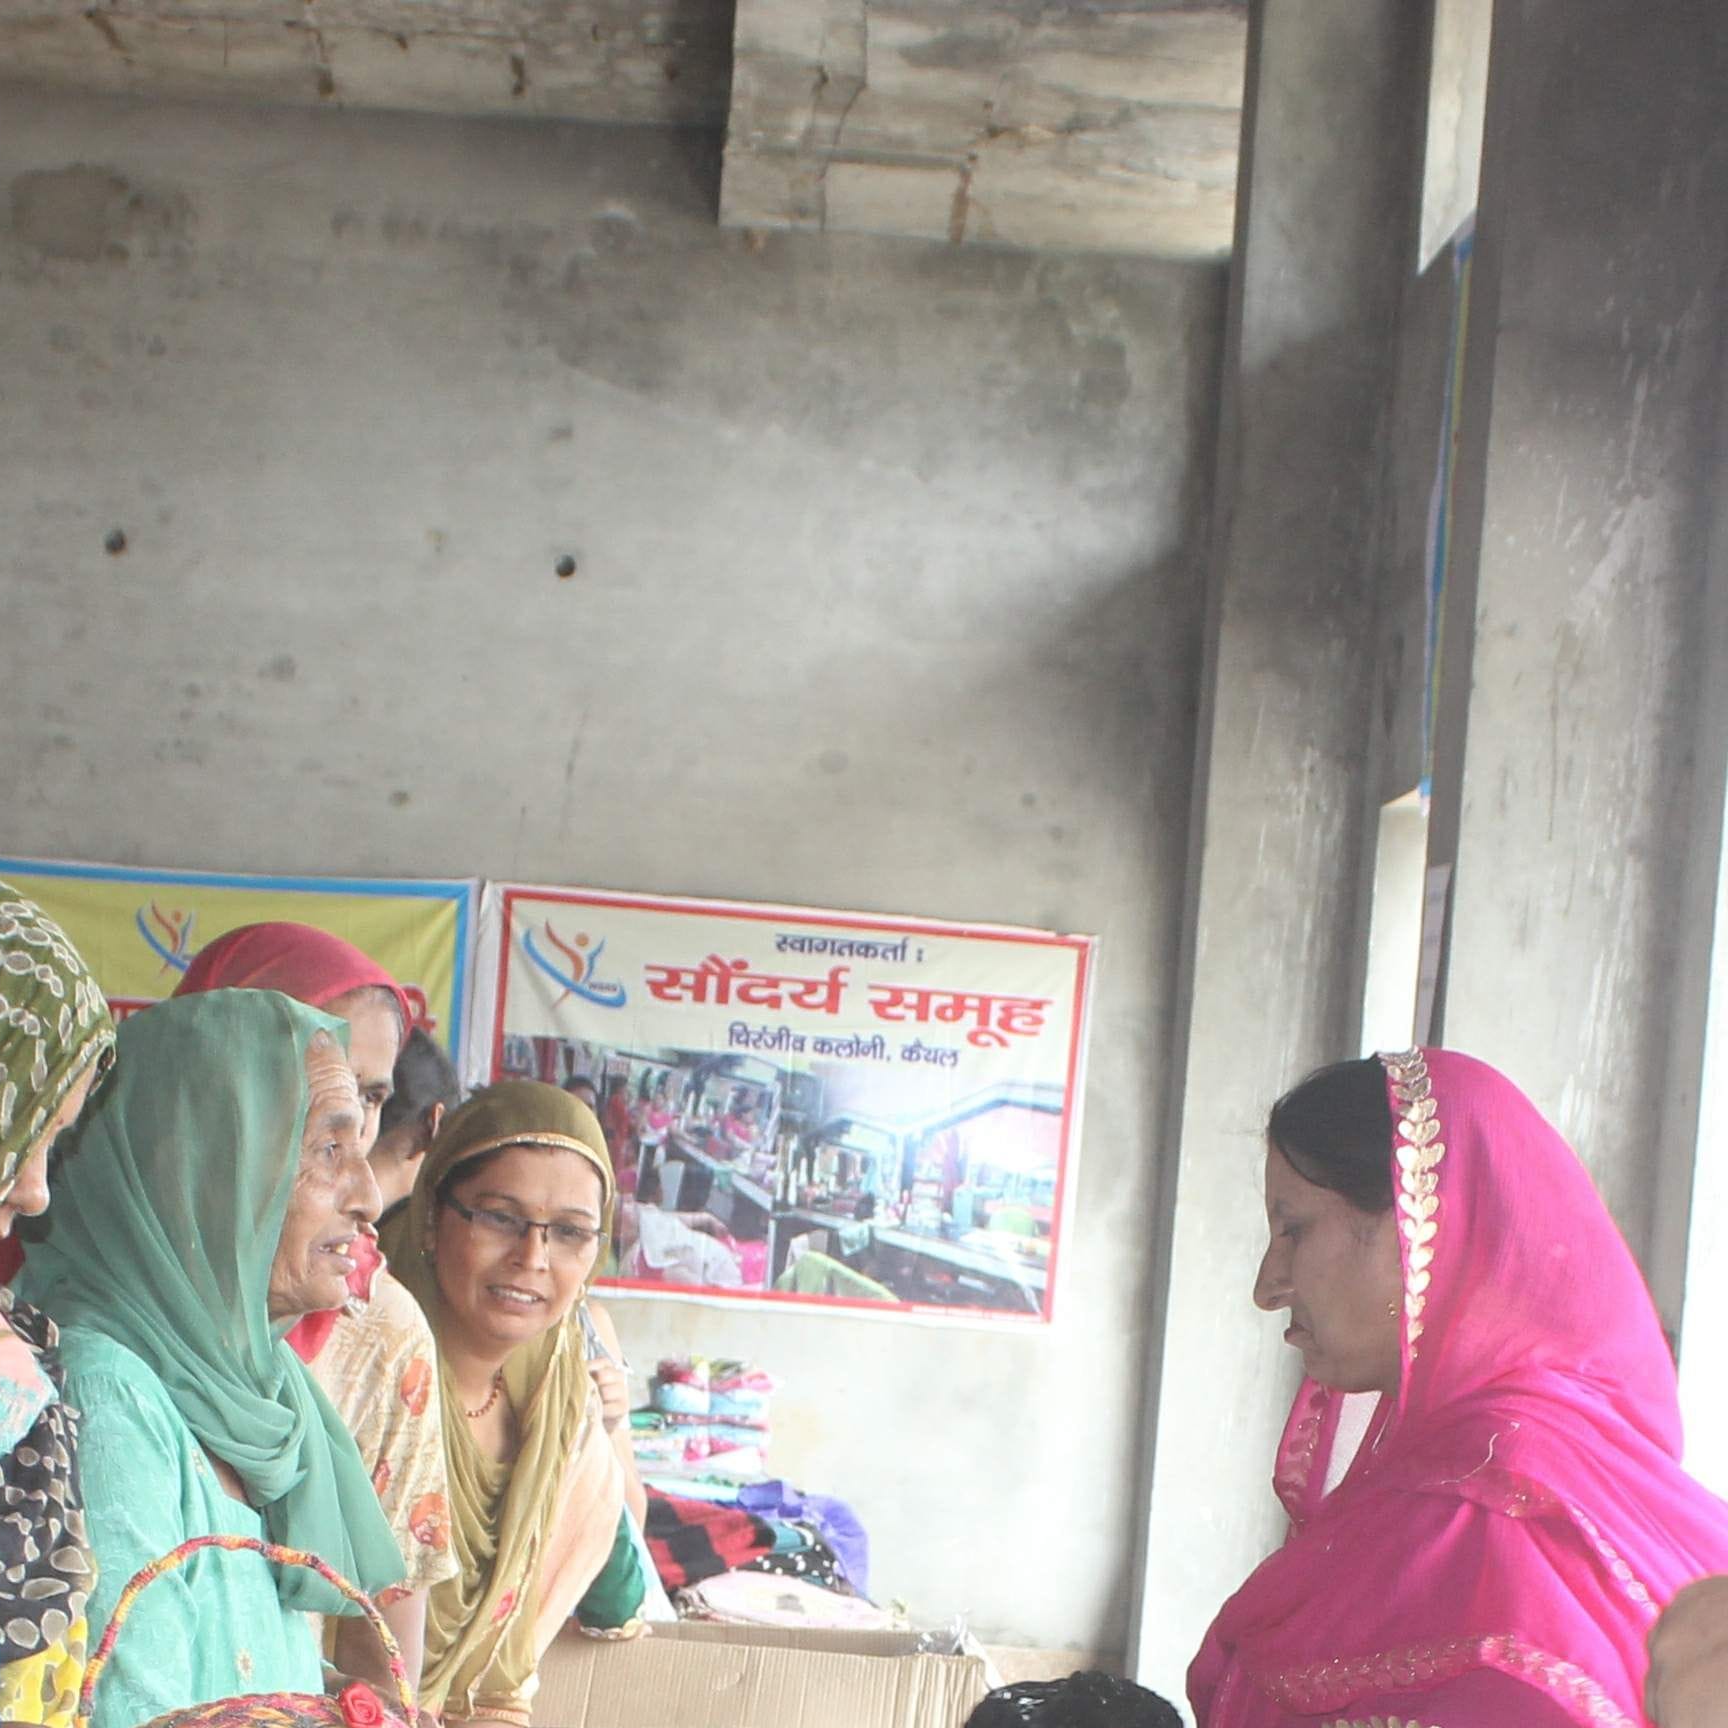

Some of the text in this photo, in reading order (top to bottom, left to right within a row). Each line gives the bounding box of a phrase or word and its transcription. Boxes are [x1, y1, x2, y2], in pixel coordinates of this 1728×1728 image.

[775, 932, 910, 963] स्वागतकर्ता
[644, 953, 1053, 1048] सौंदर्य समूह
[728, 1021, 806, 1052] चिरंजीव
